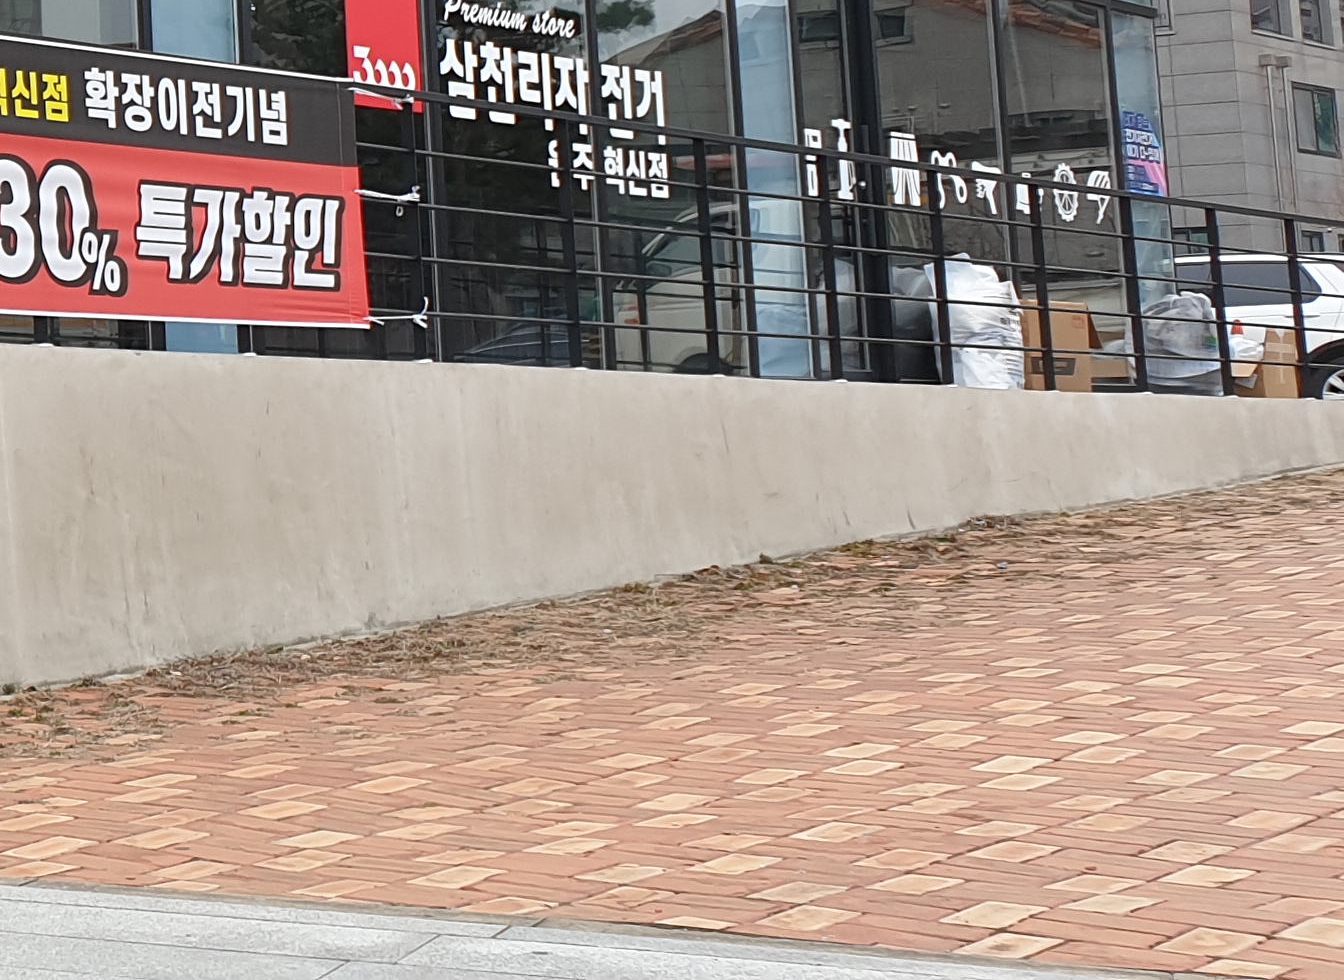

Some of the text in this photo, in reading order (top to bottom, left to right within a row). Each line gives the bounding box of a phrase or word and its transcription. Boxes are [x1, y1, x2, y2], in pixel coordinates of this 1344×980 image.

[532, 10, 576, 39] store
[83, 66, 290, 147] 확장이전기념
[135, 182, 341, 290] 특가할인
